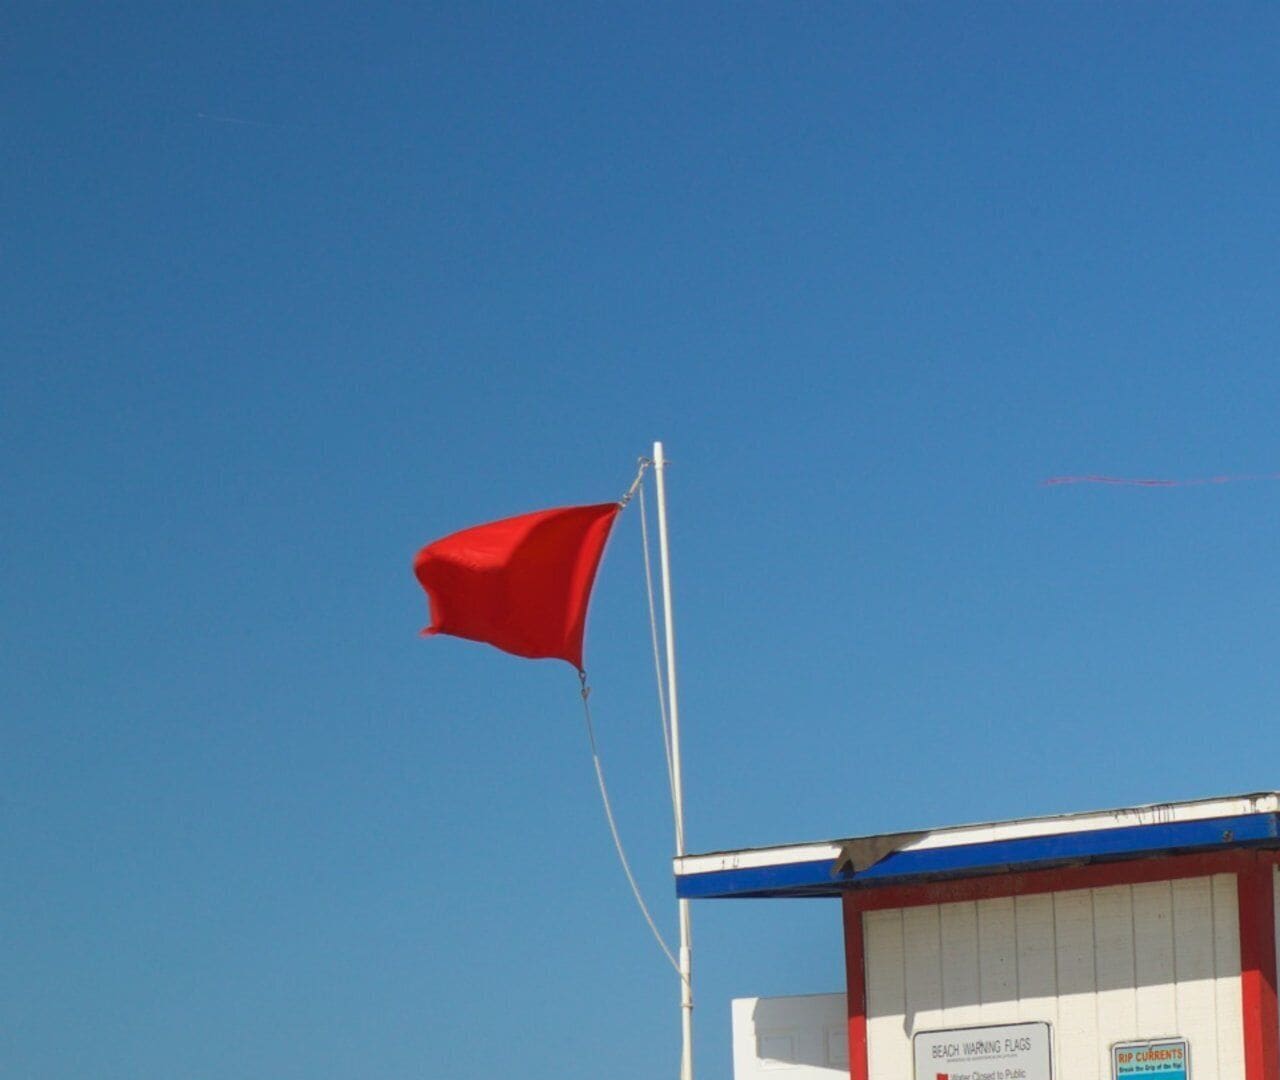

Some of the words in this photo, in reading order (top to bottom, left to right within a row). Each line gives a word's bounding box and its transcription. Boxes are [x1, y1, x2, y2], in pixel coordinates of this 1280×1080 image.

[932, 1043, 960, 1059] BEACH
[963, 1040, 1001, 1055] WARNING
[1005, 1037, 1032, 1052] FLAGS
[1118, 1052, 1134, 1064] RIP
[1136, 1048, 1184, 1062] CURRENTS
[997, 1070, 1004, 1080] to
[1005, 1068, 1026, 1080] Public
